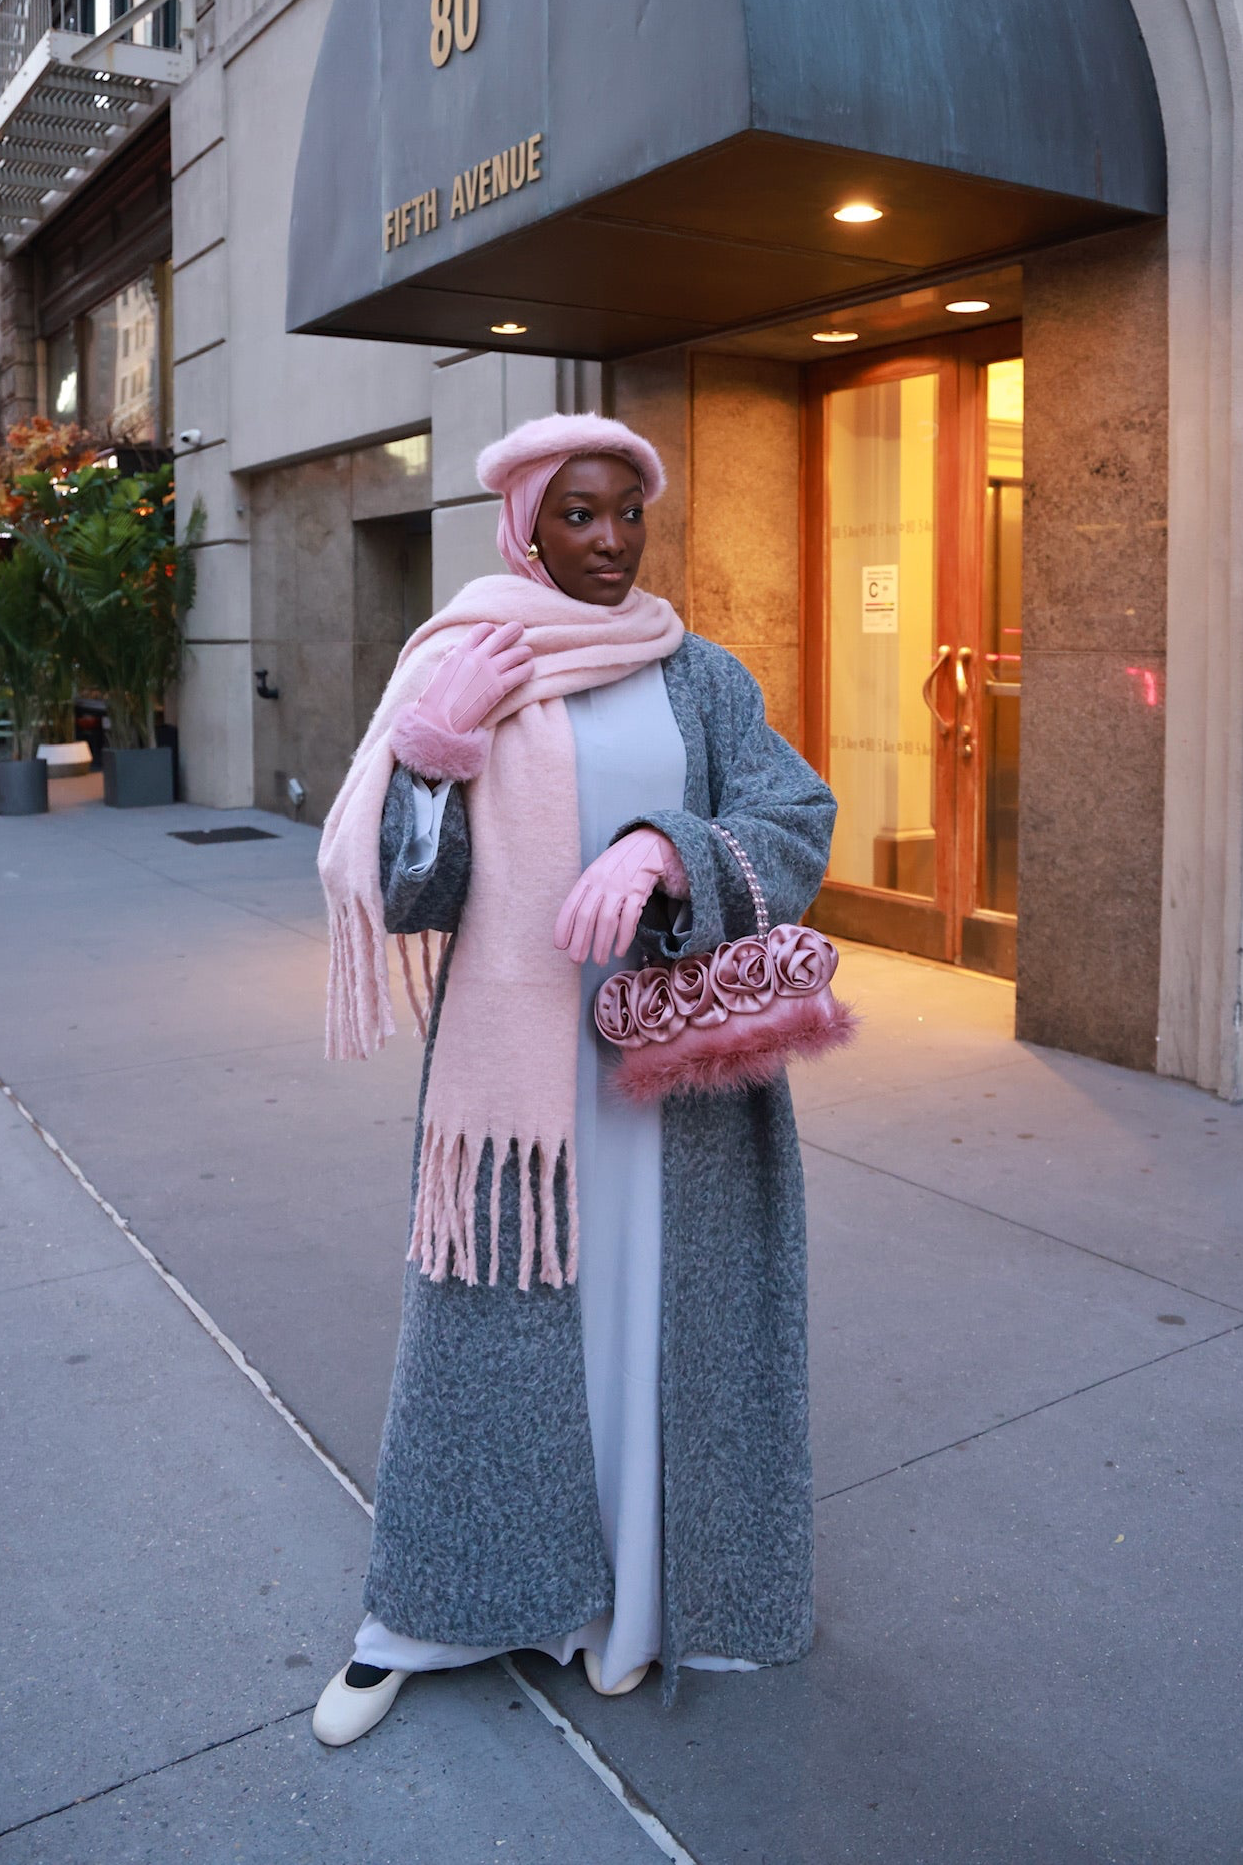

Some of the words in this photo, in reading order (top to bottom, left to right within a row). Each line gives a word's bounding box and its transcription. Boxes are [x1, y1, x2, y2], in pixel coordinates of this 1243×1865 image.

[430, 0, 480, 68] 80
[384, 187, 438, 252] FIFTH
[450, 132, 543, 220] AVENUE
[868, 581, 879, 599] C
